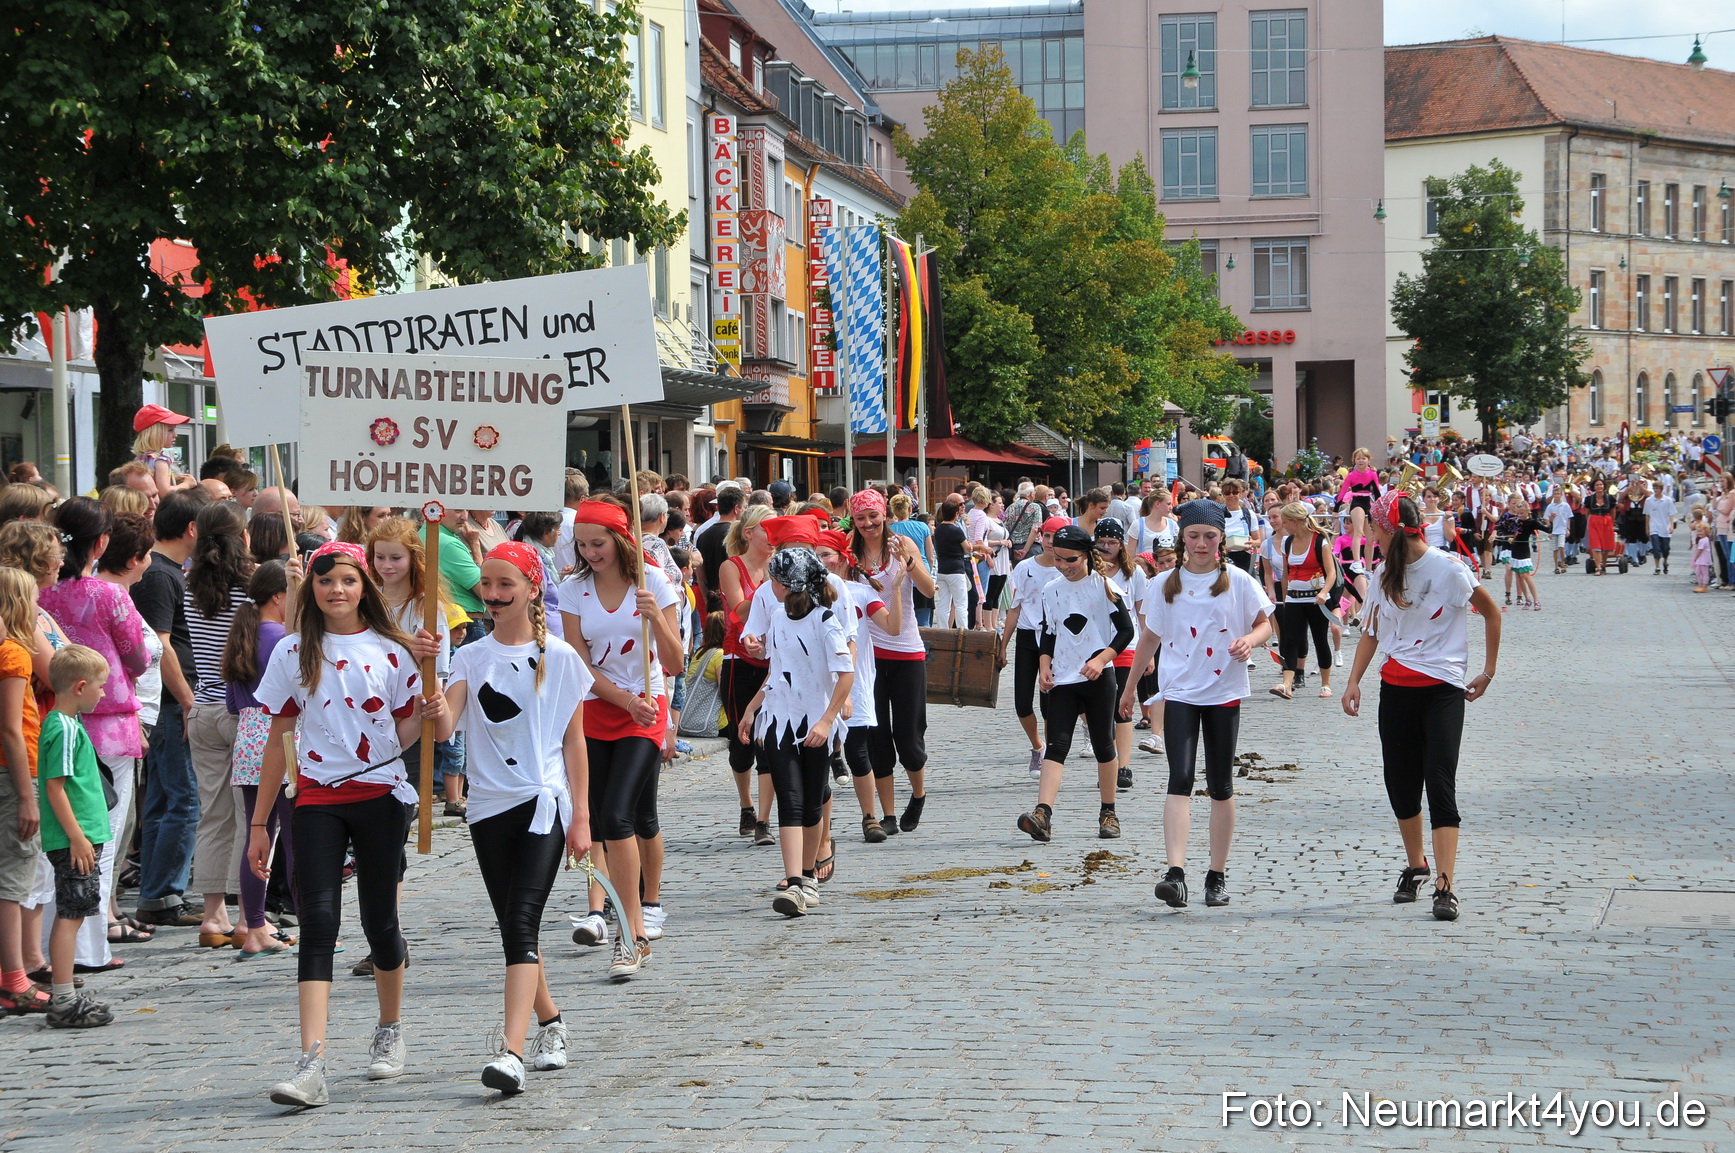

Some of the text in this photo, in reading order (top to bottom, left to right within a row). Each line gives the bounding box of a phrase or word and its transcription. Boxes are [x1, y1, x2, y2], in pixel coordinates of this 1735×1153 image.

[714, 118, 733, 312] BÄCKEREI
[257, 300, 595, 374] STADTPIRATEN und
[715, 321, 739, 336] café
[305, 365, 564, 405] TURNABTEILUNG
[412, 416, 458, 450] SV
[330, 452, 533, 497] HÖHENBERG
